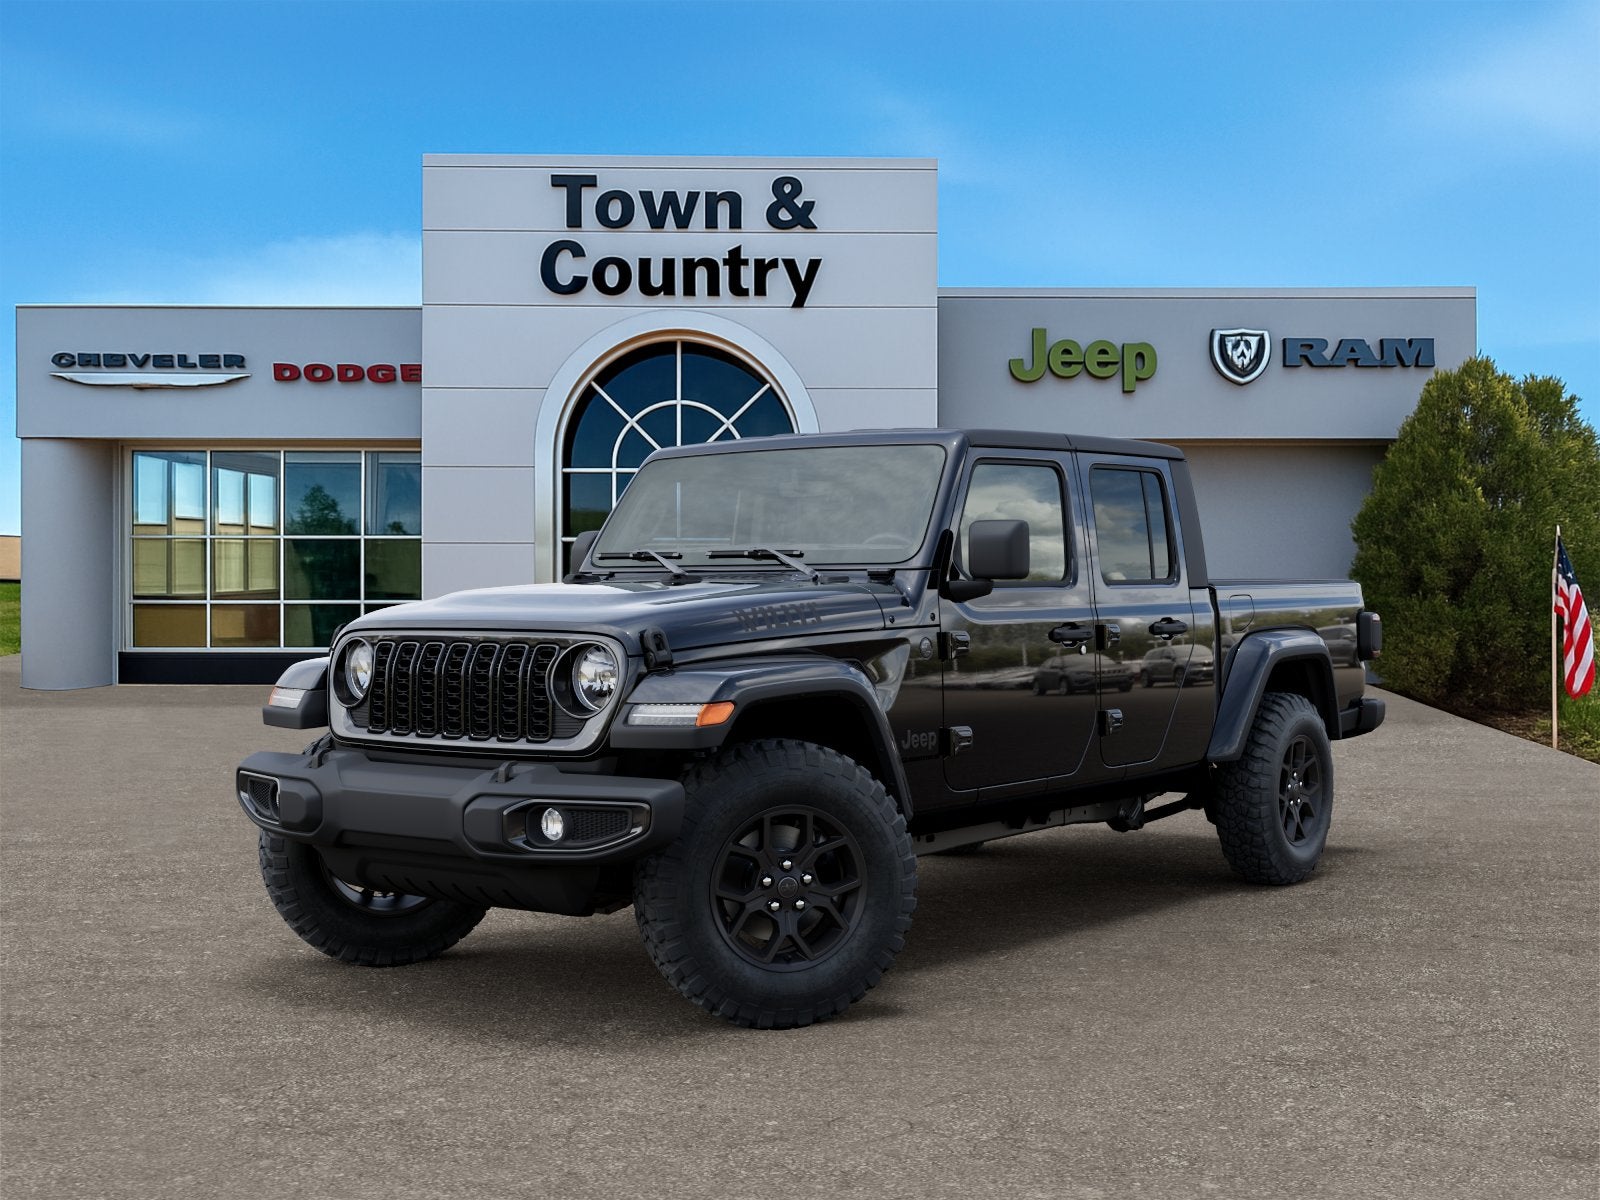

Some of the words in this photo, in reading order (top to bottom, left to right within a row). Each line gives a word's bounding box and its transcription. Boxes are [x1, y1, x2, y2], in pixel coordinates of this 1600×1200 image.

[550, 174, 742, 230] Town
[765, 176, 818, 230] &
[540, 239, 822, 308] Country
[273, 363, 422, 383] DODGE
[1009, 328, 1157, 393] Jeep
[1282, 338, 1435, 368] RAM
[901, 729, 937, 751] Jeep
